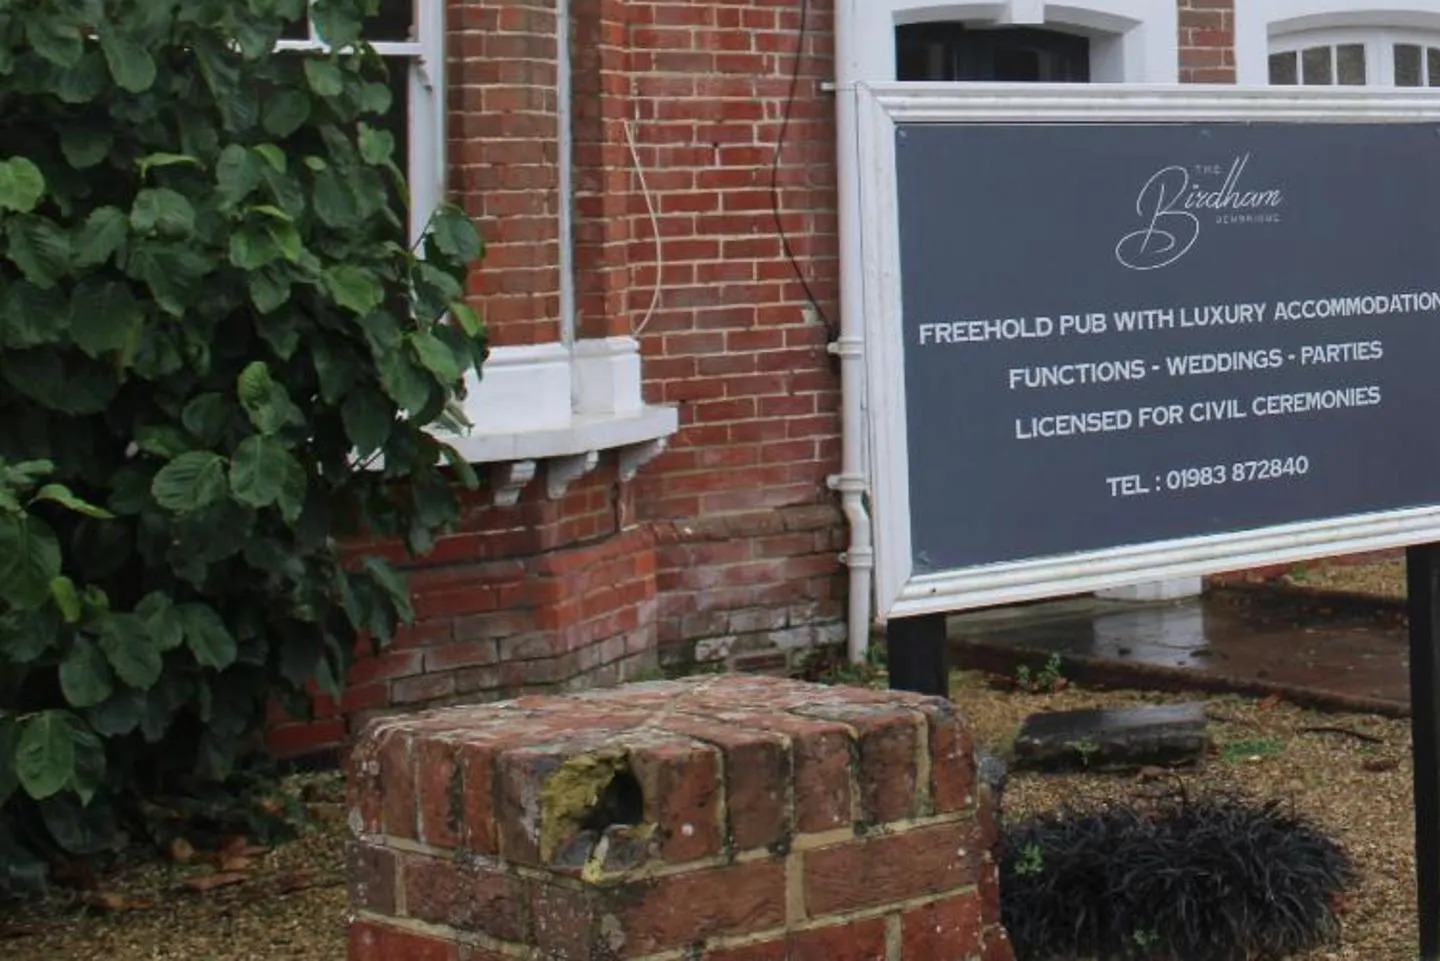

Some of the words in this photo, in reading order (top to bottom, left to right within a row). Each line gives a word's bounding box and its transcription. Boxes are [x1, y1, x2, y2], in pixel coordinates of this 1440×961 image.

[1195, 164, 1222, 175] THE
[1115, 152, 1282, 270] Birdham
[918, 317, 1053, 344] FREEHOLD
[1060, 313, 1106, 335] PUB
[1113, 308, 1174, 331] WITH
[1180, 303, 1266, 327] LUXURY
[1009, 359, 1145, 389] FUNCTIONS
[1166, 349, 1283, 376] WEDDINGS
[1301, 340, 1383, 365] PARTIES
[1016, 409, 1132, 439] LICENSED
[1138, 405, 1183, 427] FOR
[1190, 399, 1247, 422] CIVIL
[1252, 386, 1381, 416] CEREMONIES
[1106, 474, 1149, 496] TEL
[1166, 465, 1226, 489] 01983
[1232, 455, 1309, 482] 872840
